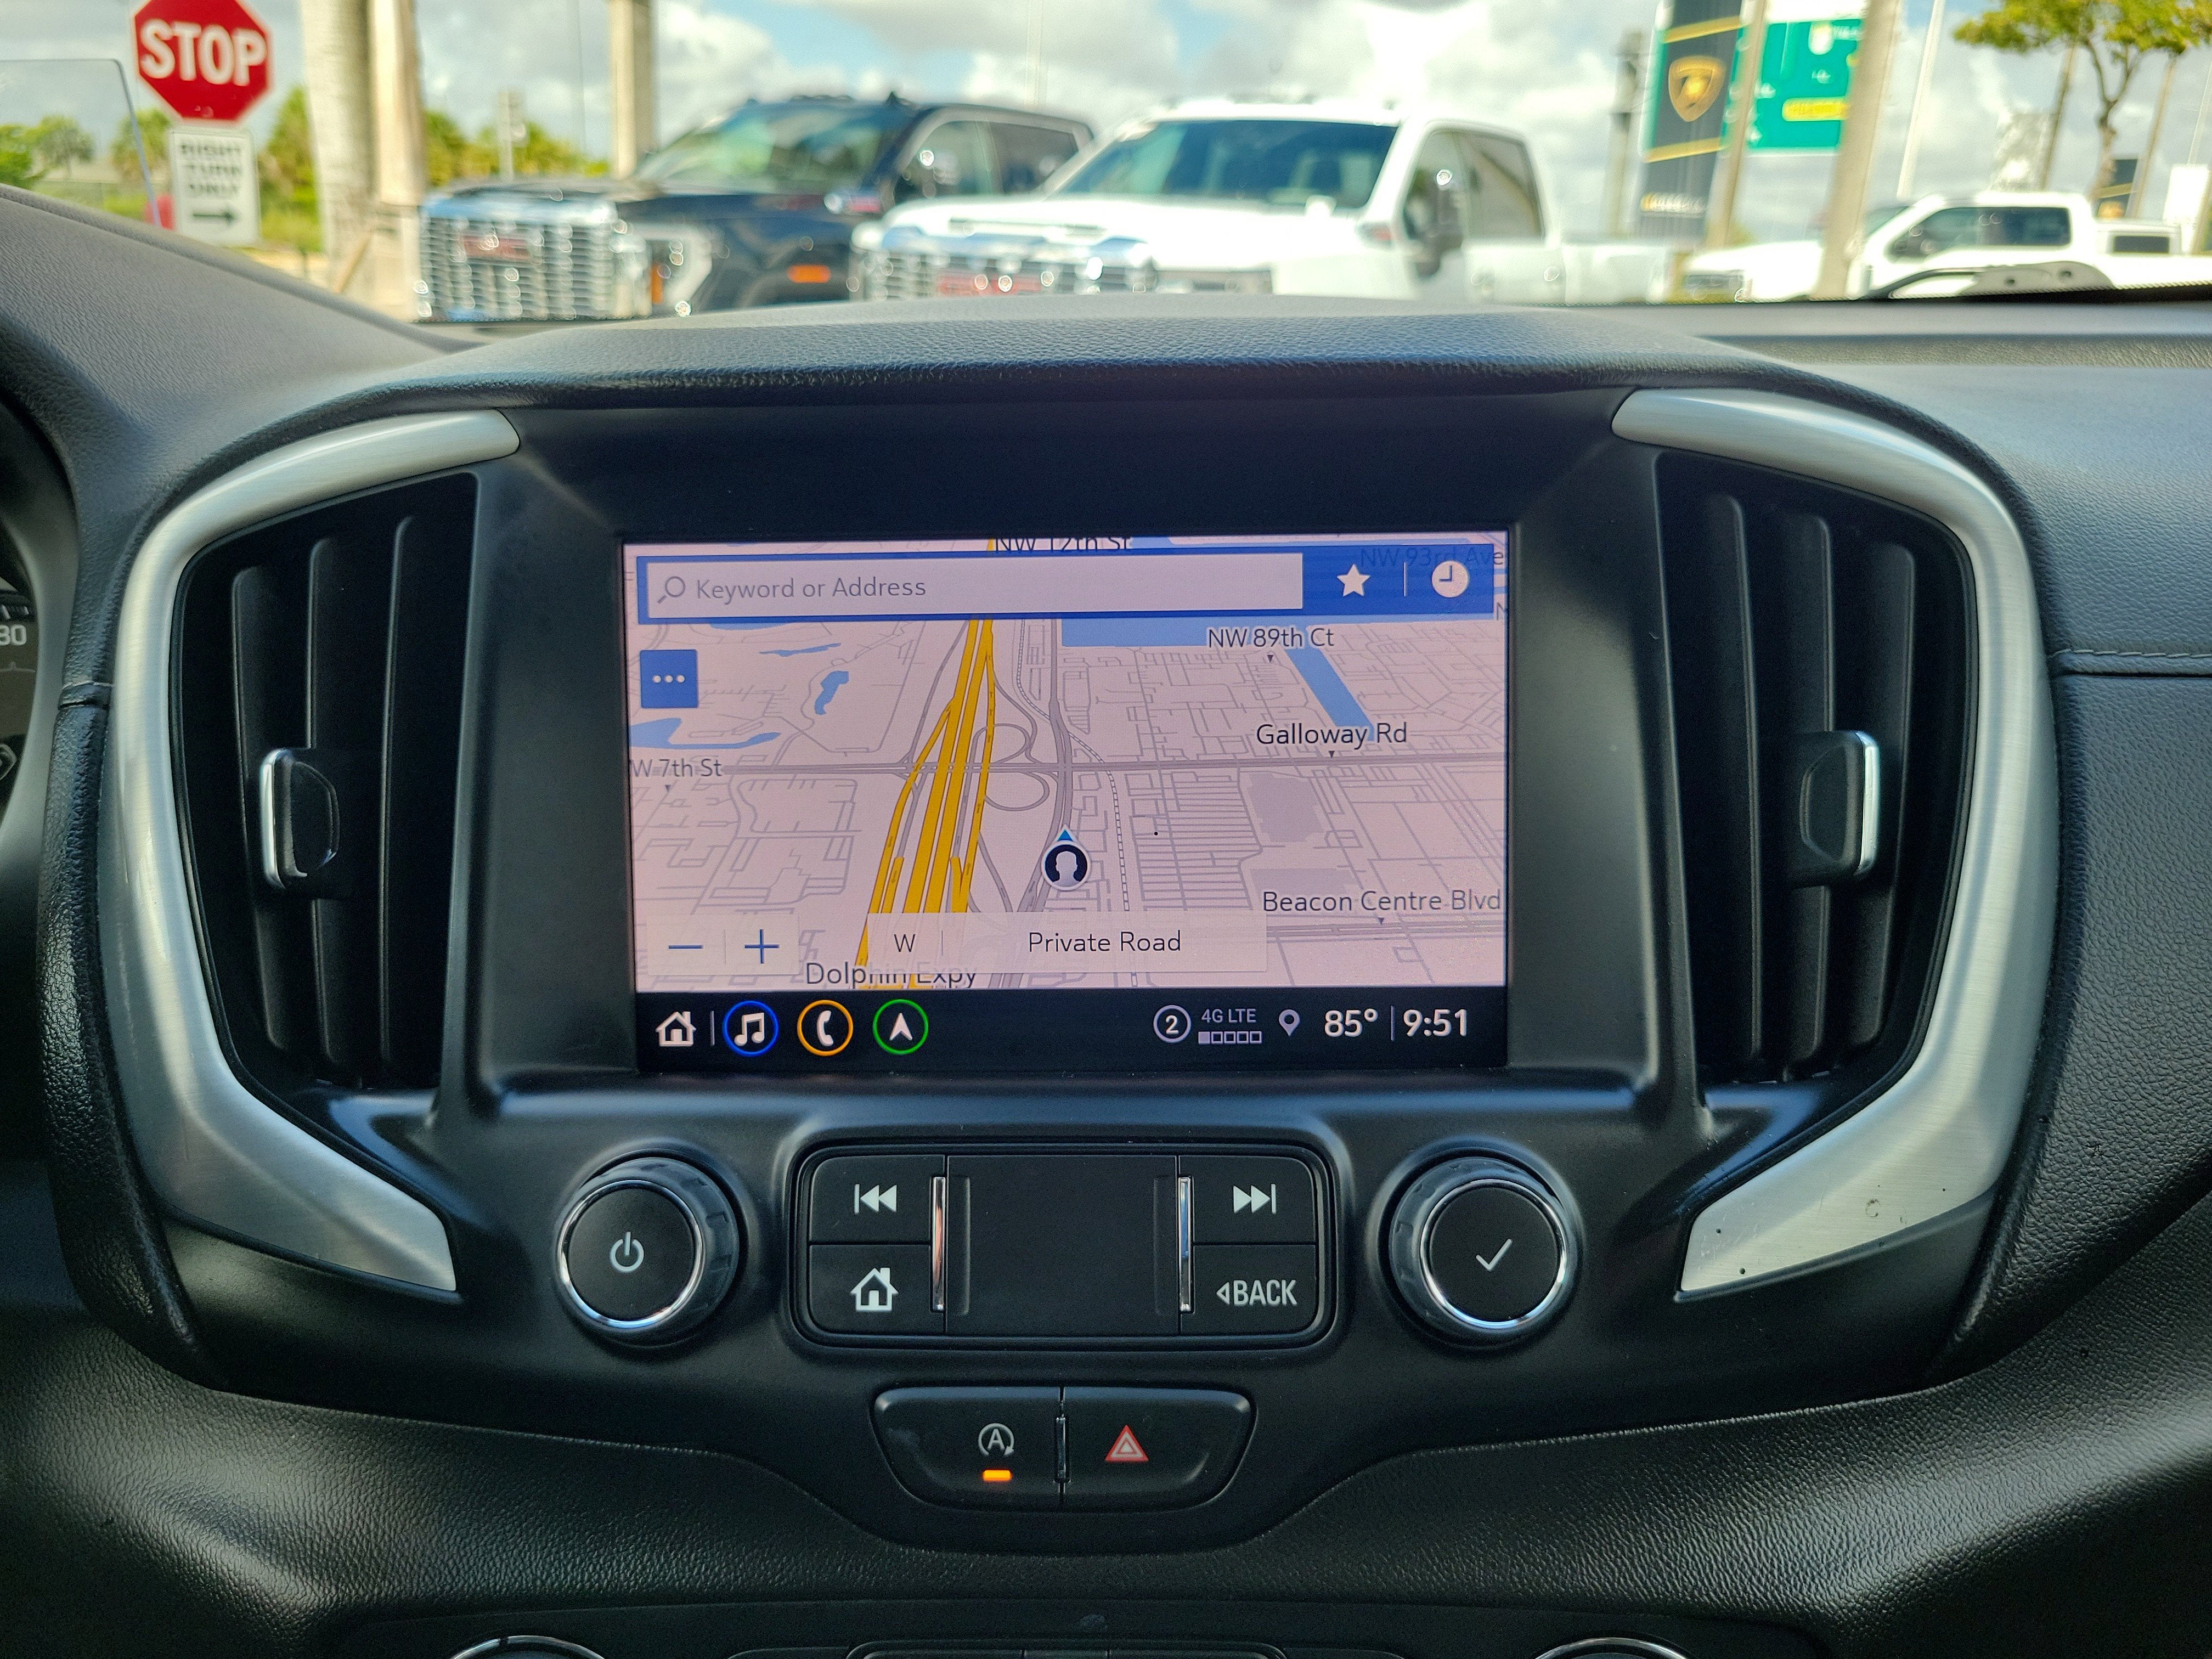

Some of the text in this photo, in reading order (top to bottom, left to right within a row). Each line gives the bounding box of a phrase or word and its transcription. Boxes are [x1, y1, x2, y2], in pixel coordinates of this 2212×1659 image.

[140, 18, 268, 87] STOP
[996, 538, 1036, 552] NW
[1107, 537, 1131, 551] St
[697, 577, 926, 605] Keyword or Address
[1209, 627, 1334, 648] NW 89th Ct
[1256, 721, 1407, 750] Galloway Rd
[659, 758, 693, 777] 7th
[701, 758, 722, 776] St
[1263, 888, 1501, 912] Beacon Centre Blvd
[894, 930, 1181, 952] W Private Road
[806, 961, 978, 989] Dolphin Expy
[1165, 1008, 1468, 1037] 2 4G LTE 85° 9:51
[1233, 1279, 1297, 1306] BACK
[988, 1428, 1005, 1450] A
